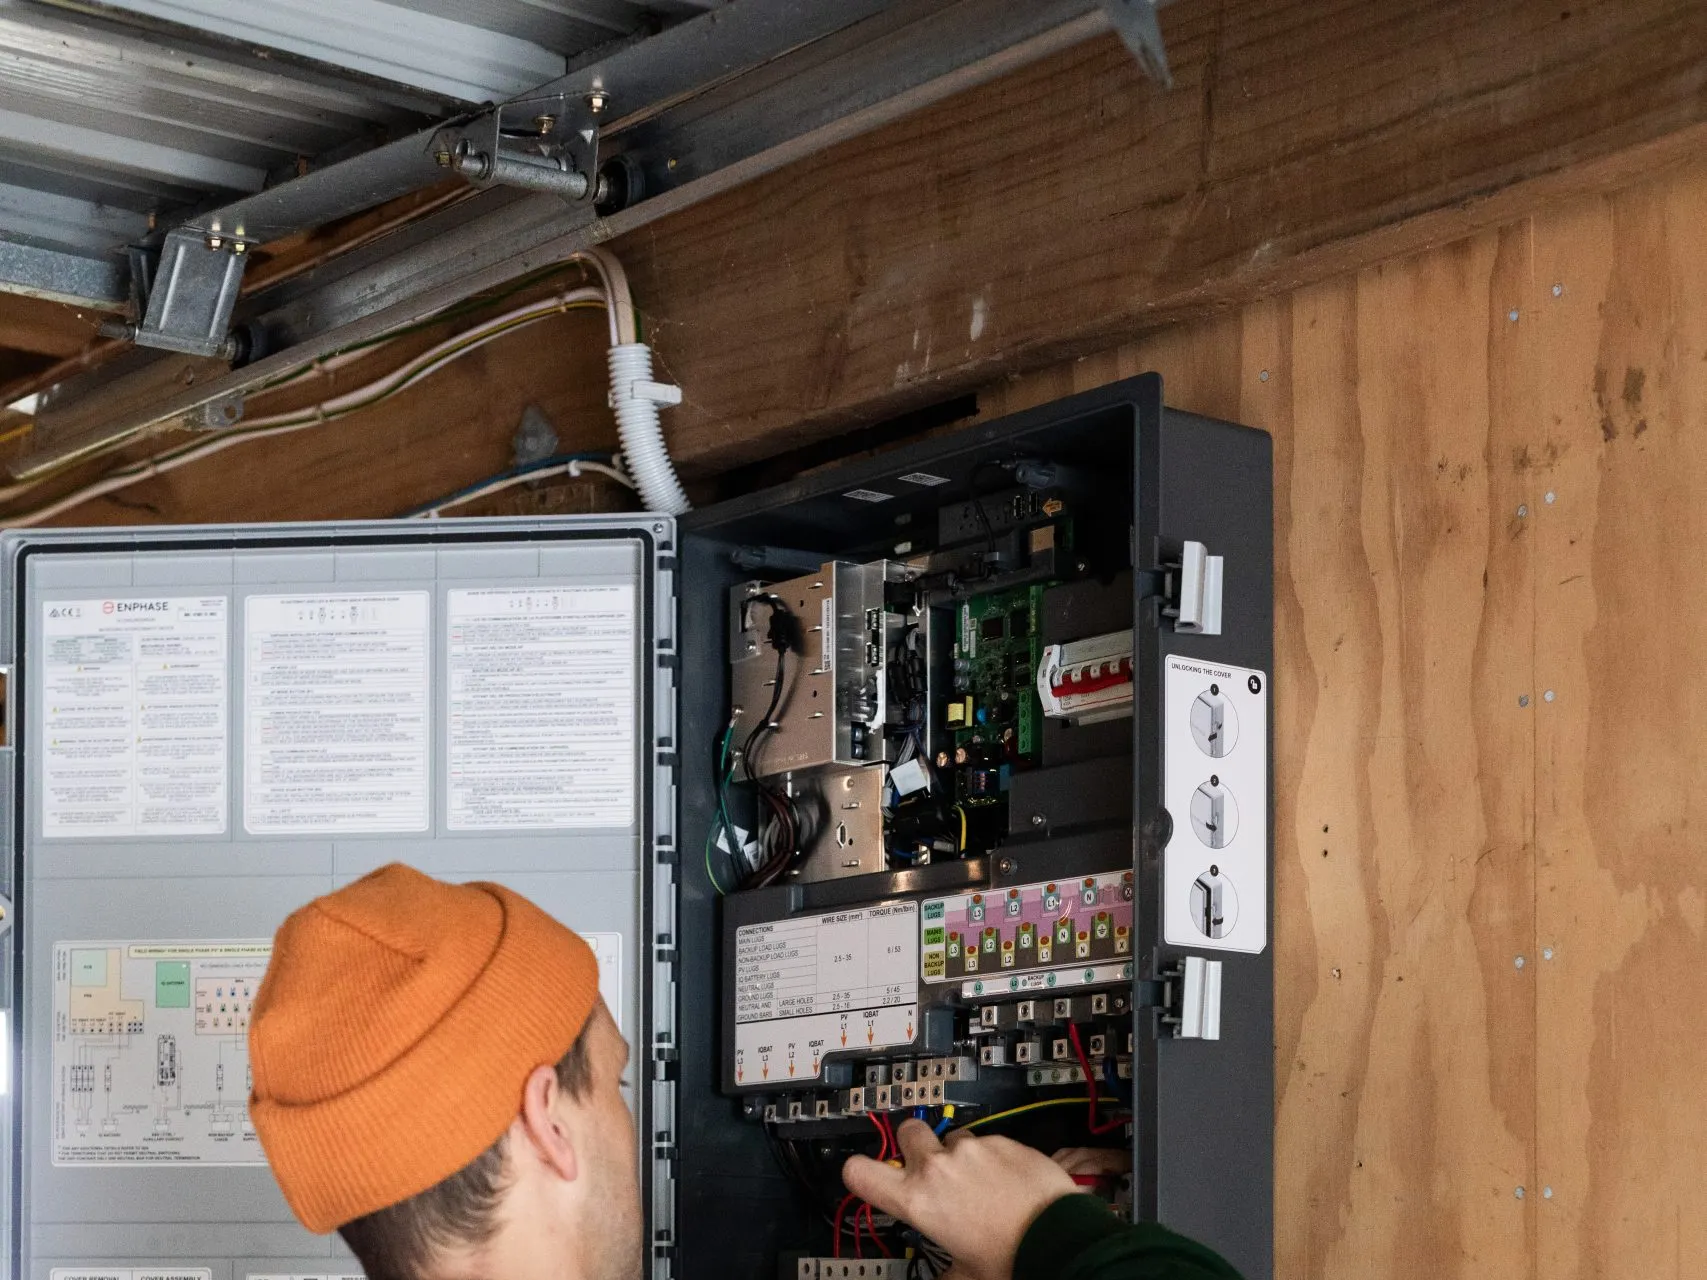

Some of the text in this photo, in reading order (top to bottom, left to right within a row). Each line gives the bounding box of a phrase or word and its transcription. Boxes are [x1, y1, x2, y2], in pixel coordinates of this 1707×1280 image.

[117, 602, 169, 612] ENPHASE
[1172, 663, 1232, 679] UNLOCKING THE COVER
[924, 902, 944, 911] BACKUP
[869, 908, 891, 917] TORQUE
[927, 911, 940, 919] LUGS
[822, 916, 835, 924] WIRE
[836, 914, 848, 922] SIZE
[738, 926, 774, 936] CONNECTIONS
[927, 936, 940, 944] LUGS
[738, 942, 786, 954] BACKUP LOAD LUGS
[770, 952, 784, 960] LOAD
[785, 950, 798, 958] LUGS
[924, 960, 944, 968] BACKUP
[744, 973, 766, 982] BATTERY
[766, 971, 780, 979] LUGS
[761, 982, 774, 990] LUGS
[760, 992, 774, 1000] LUGS
[779, 996, 814, 1007] LARGE HOLES
[779, 1006, 813, 1017] SMALL HOLES
[863, 1010, 879, 1019] IQBAT
[788, 1042, 796, 1050] PV
[808, 1039, 824, 1048] IQBAT
[758, 1045, 773, 1054] IQBAT
